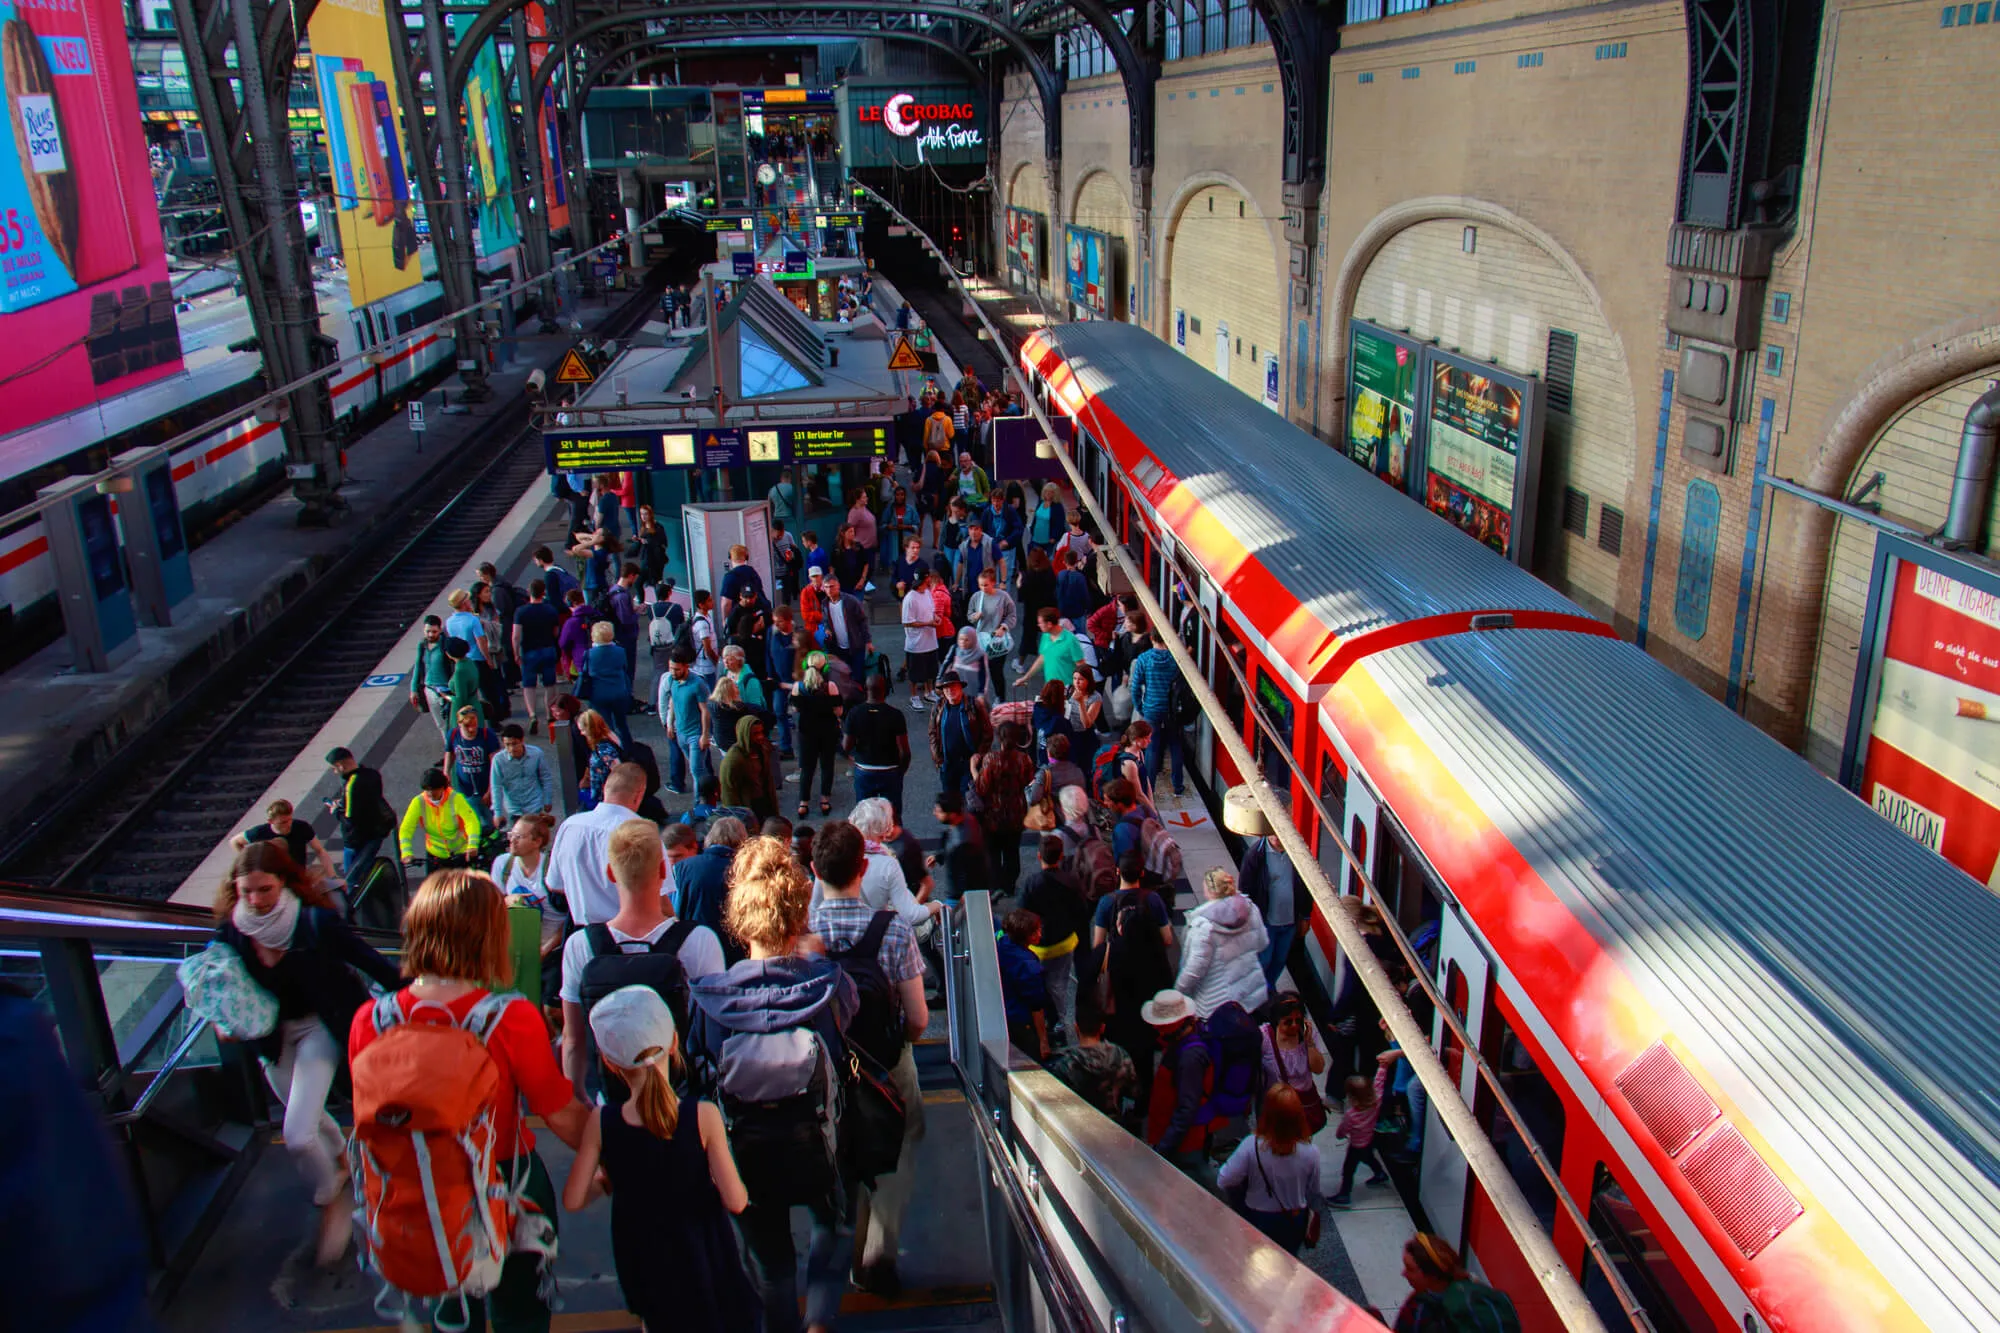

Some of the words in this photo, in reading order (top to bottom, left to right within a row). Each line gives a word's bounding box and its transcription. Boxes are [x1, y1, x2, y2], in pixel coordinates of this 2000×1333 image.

[52, 40, 87, 70] NEU
[858, 105, 881, 121] LE
[901, 103, 974, 121] CROBAG
[31, 138, 59, 156] SPORT
[945, 123, 983, 150] France
[410, 403, 422, 420] H
[560, 440, 573, 449] S21
[793, 431, 805, 440] S31
[807, 431, 833, 440] Berliner
[833, 430, 844, 439] Tor
[1919, 566, 1952, 602] DEINE
[1958, 583, 2000, 622] ZIGARE
[1877, 788, 1939, 850] BURTON
